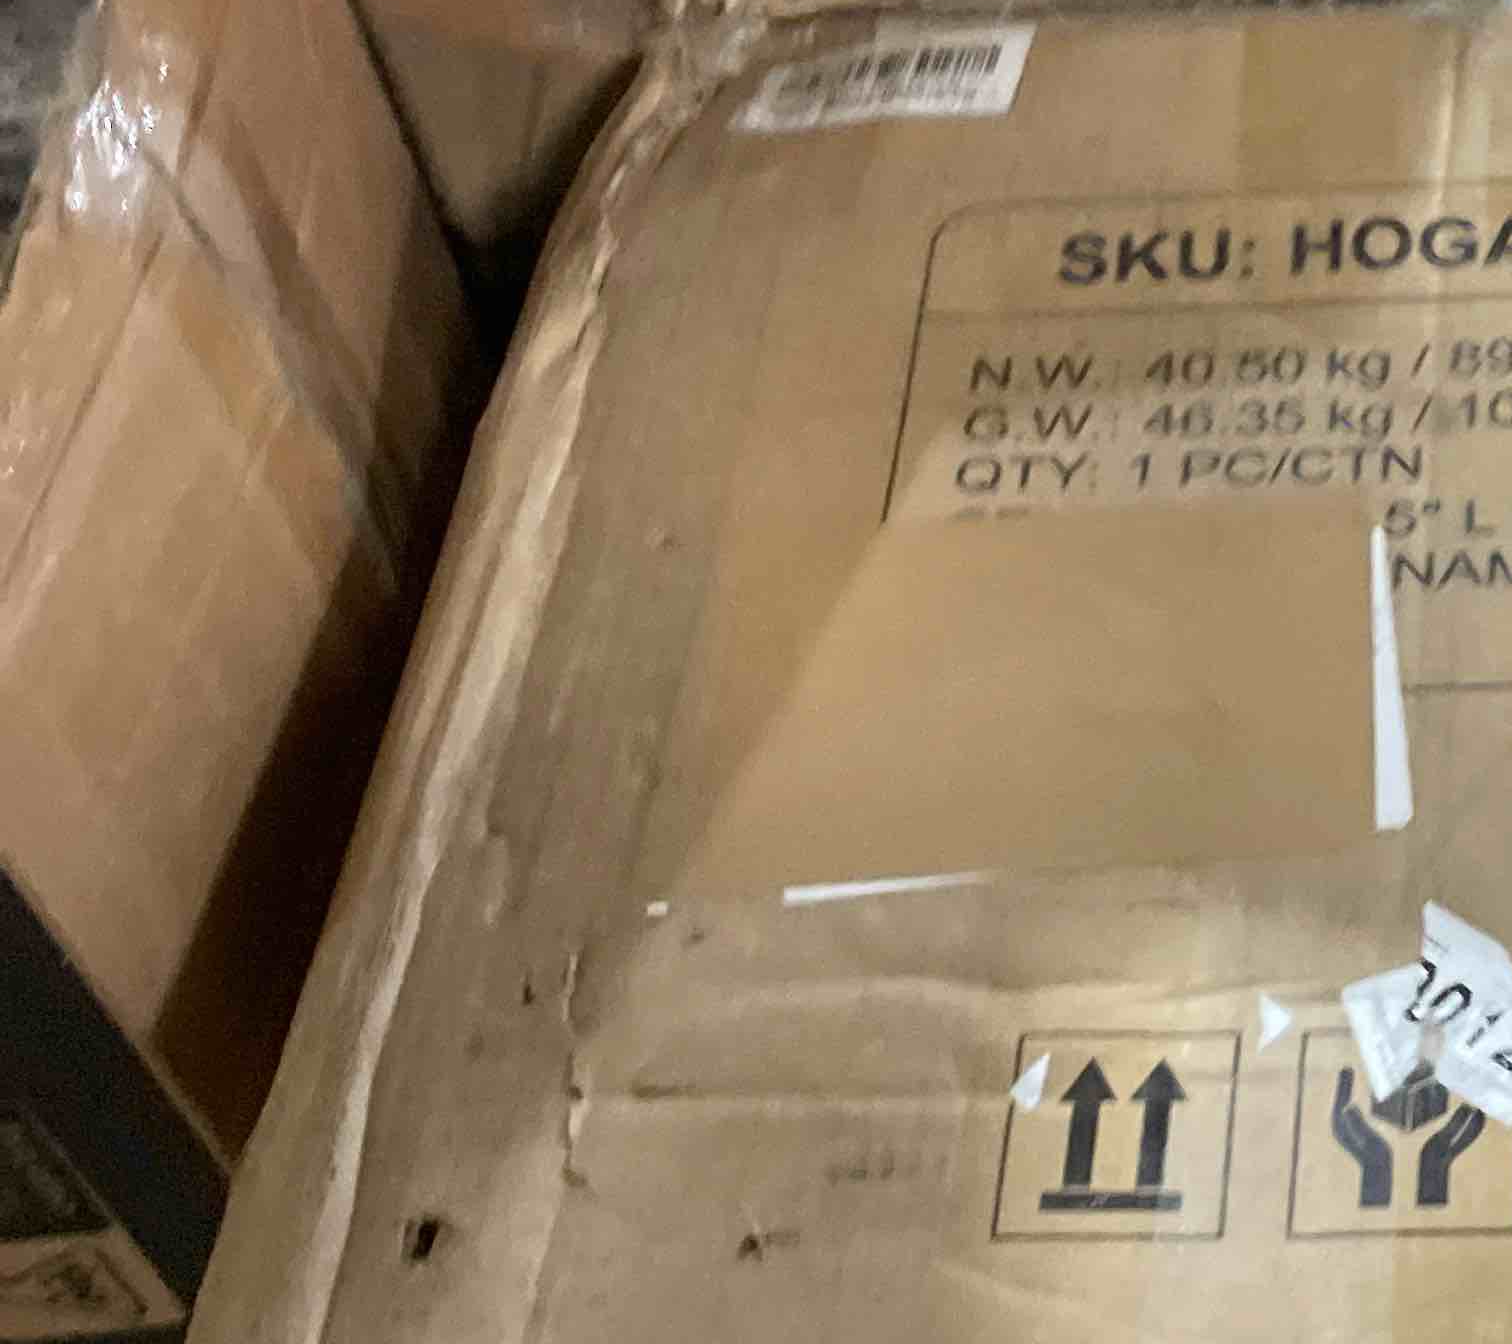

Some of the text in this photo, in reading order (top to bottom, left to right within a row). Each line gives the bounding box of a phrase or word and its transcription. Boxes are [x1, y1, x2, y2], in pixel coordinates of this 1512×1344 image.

[1057, 226, 1257, 286] SKU:
[1326, 345, 1392, 390] kg
[1410, 343, 1431, 377] /
[1326, 394, 1393, 440] kg
[1410, 395, 1434, 433] /
[954, 445, 1424, 496] QTY: 1 PC/CTN
